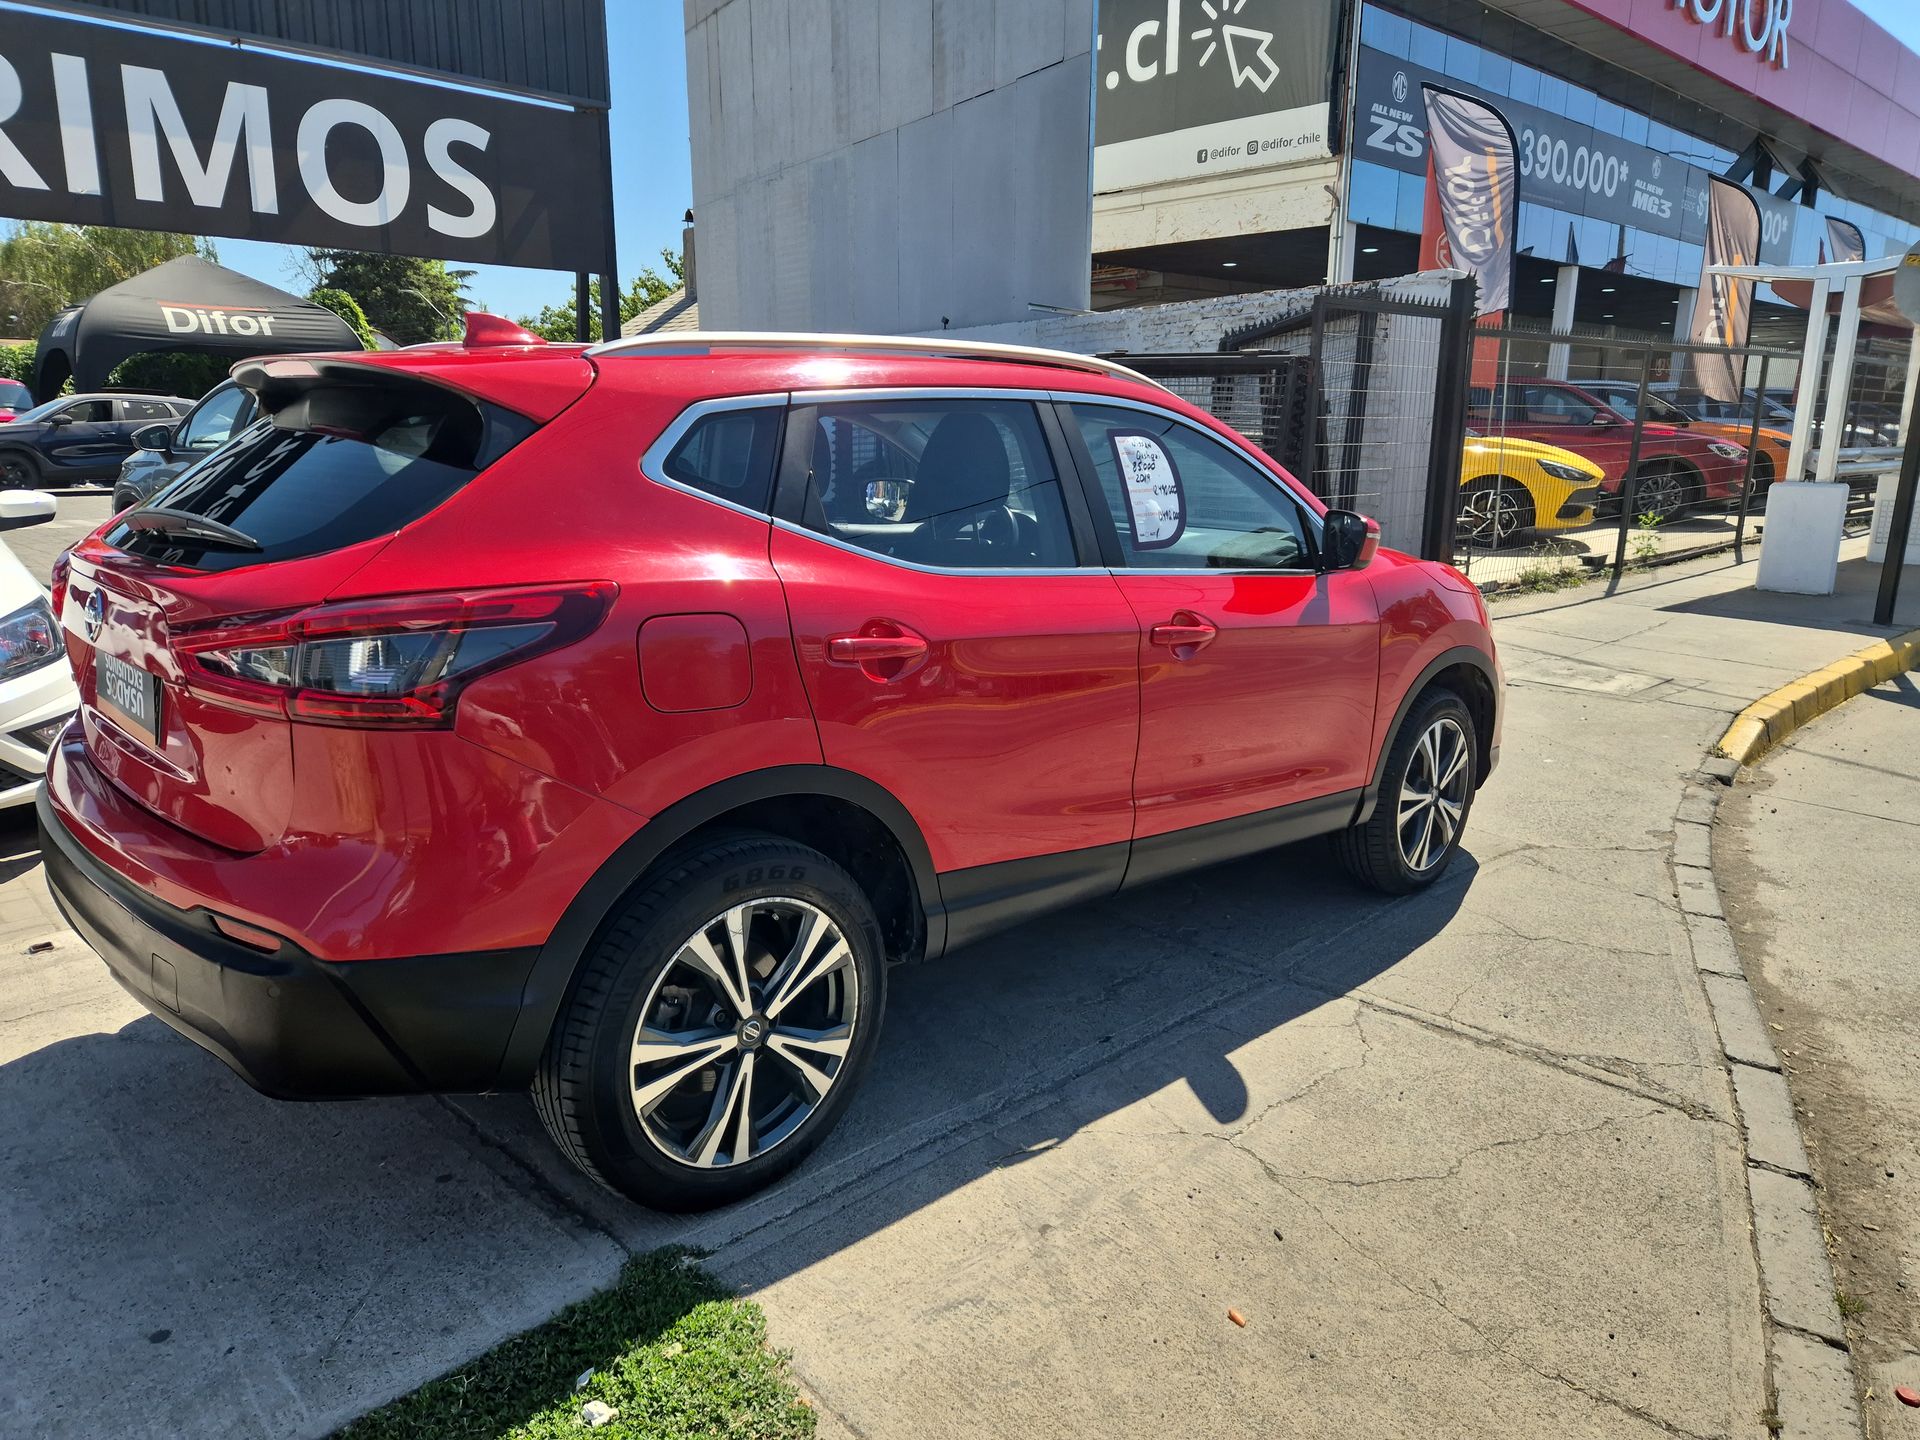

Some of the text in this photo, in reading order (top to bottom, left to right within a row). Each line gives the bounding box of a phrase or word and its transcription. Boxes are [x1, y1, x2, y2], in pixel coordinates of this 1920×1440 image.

[1371, 103, 1413, 122] ALL NEW
[1210, 133, 1321, 160] @difor @difor_chile
[1367, 115, 1424, 158] ZS
[1635, 179, 1664, 196] ALL NEW
[1632, 189, 1672, 219] MG3
[161, 306, 275, 336] Difor
[104, 652, 144, 692] EXCLUSIVOS
[106, 670, 145, 720] USADOS
